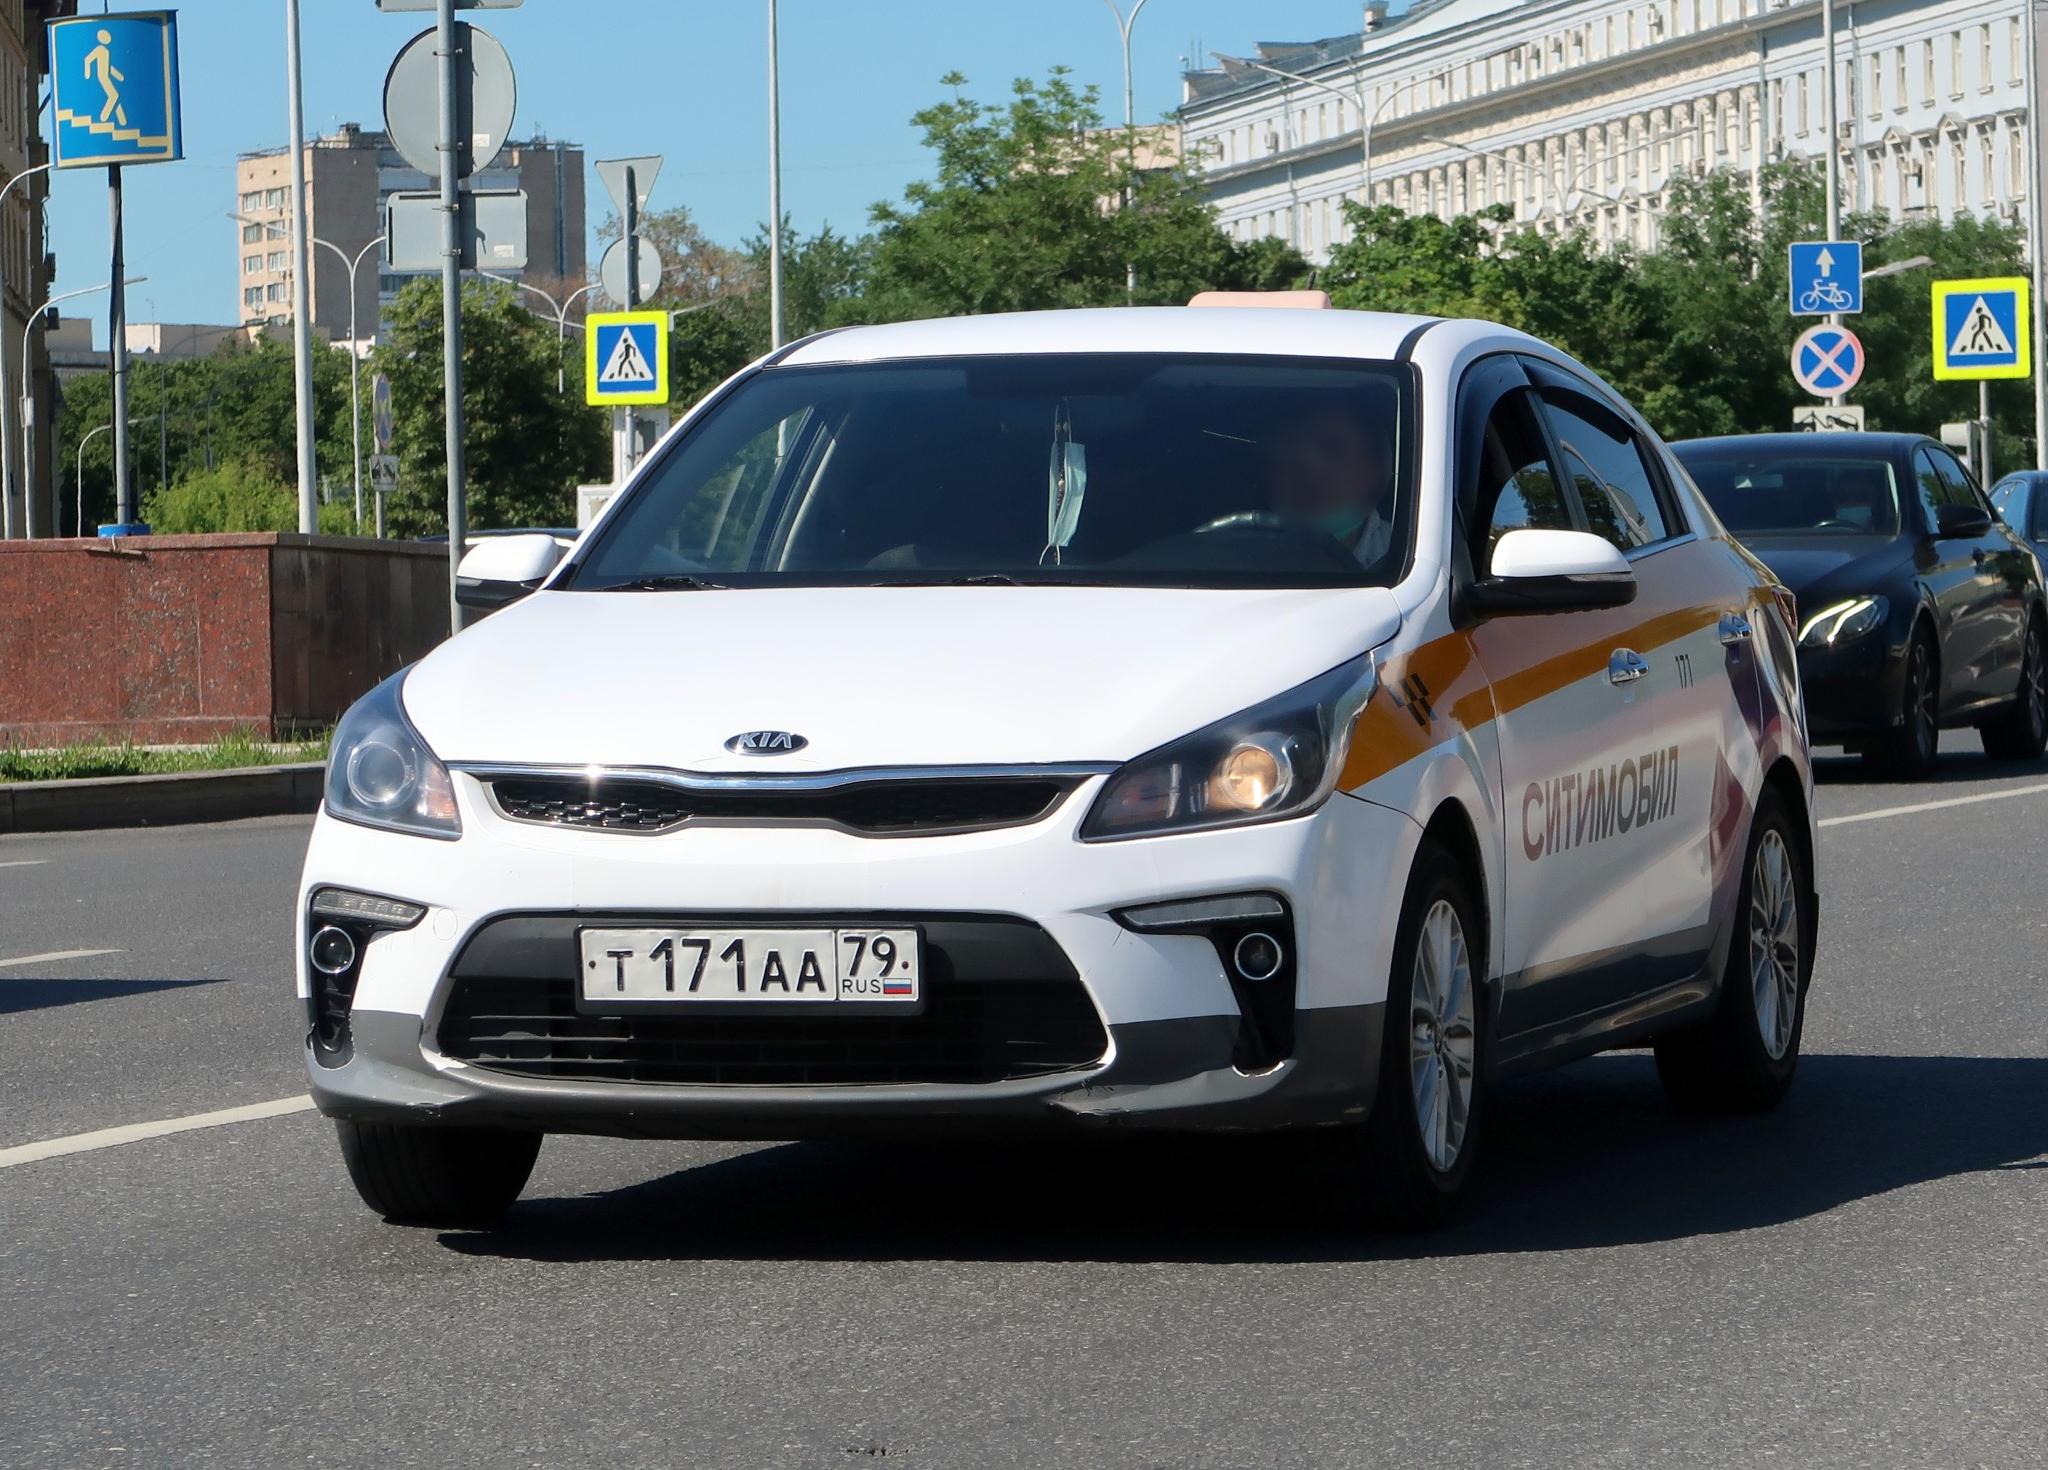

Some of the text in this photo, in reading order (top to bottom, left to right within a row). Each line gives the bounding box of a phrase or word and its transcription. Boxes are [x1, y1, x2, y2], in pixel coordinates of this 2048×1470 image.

[736, 732, 792, 750] KIA
[1522, 745, 1679, 861] СИТИМОБИЛ
[843, 936, 898, 977] 79
[842, 979, 881, 994] RUS
